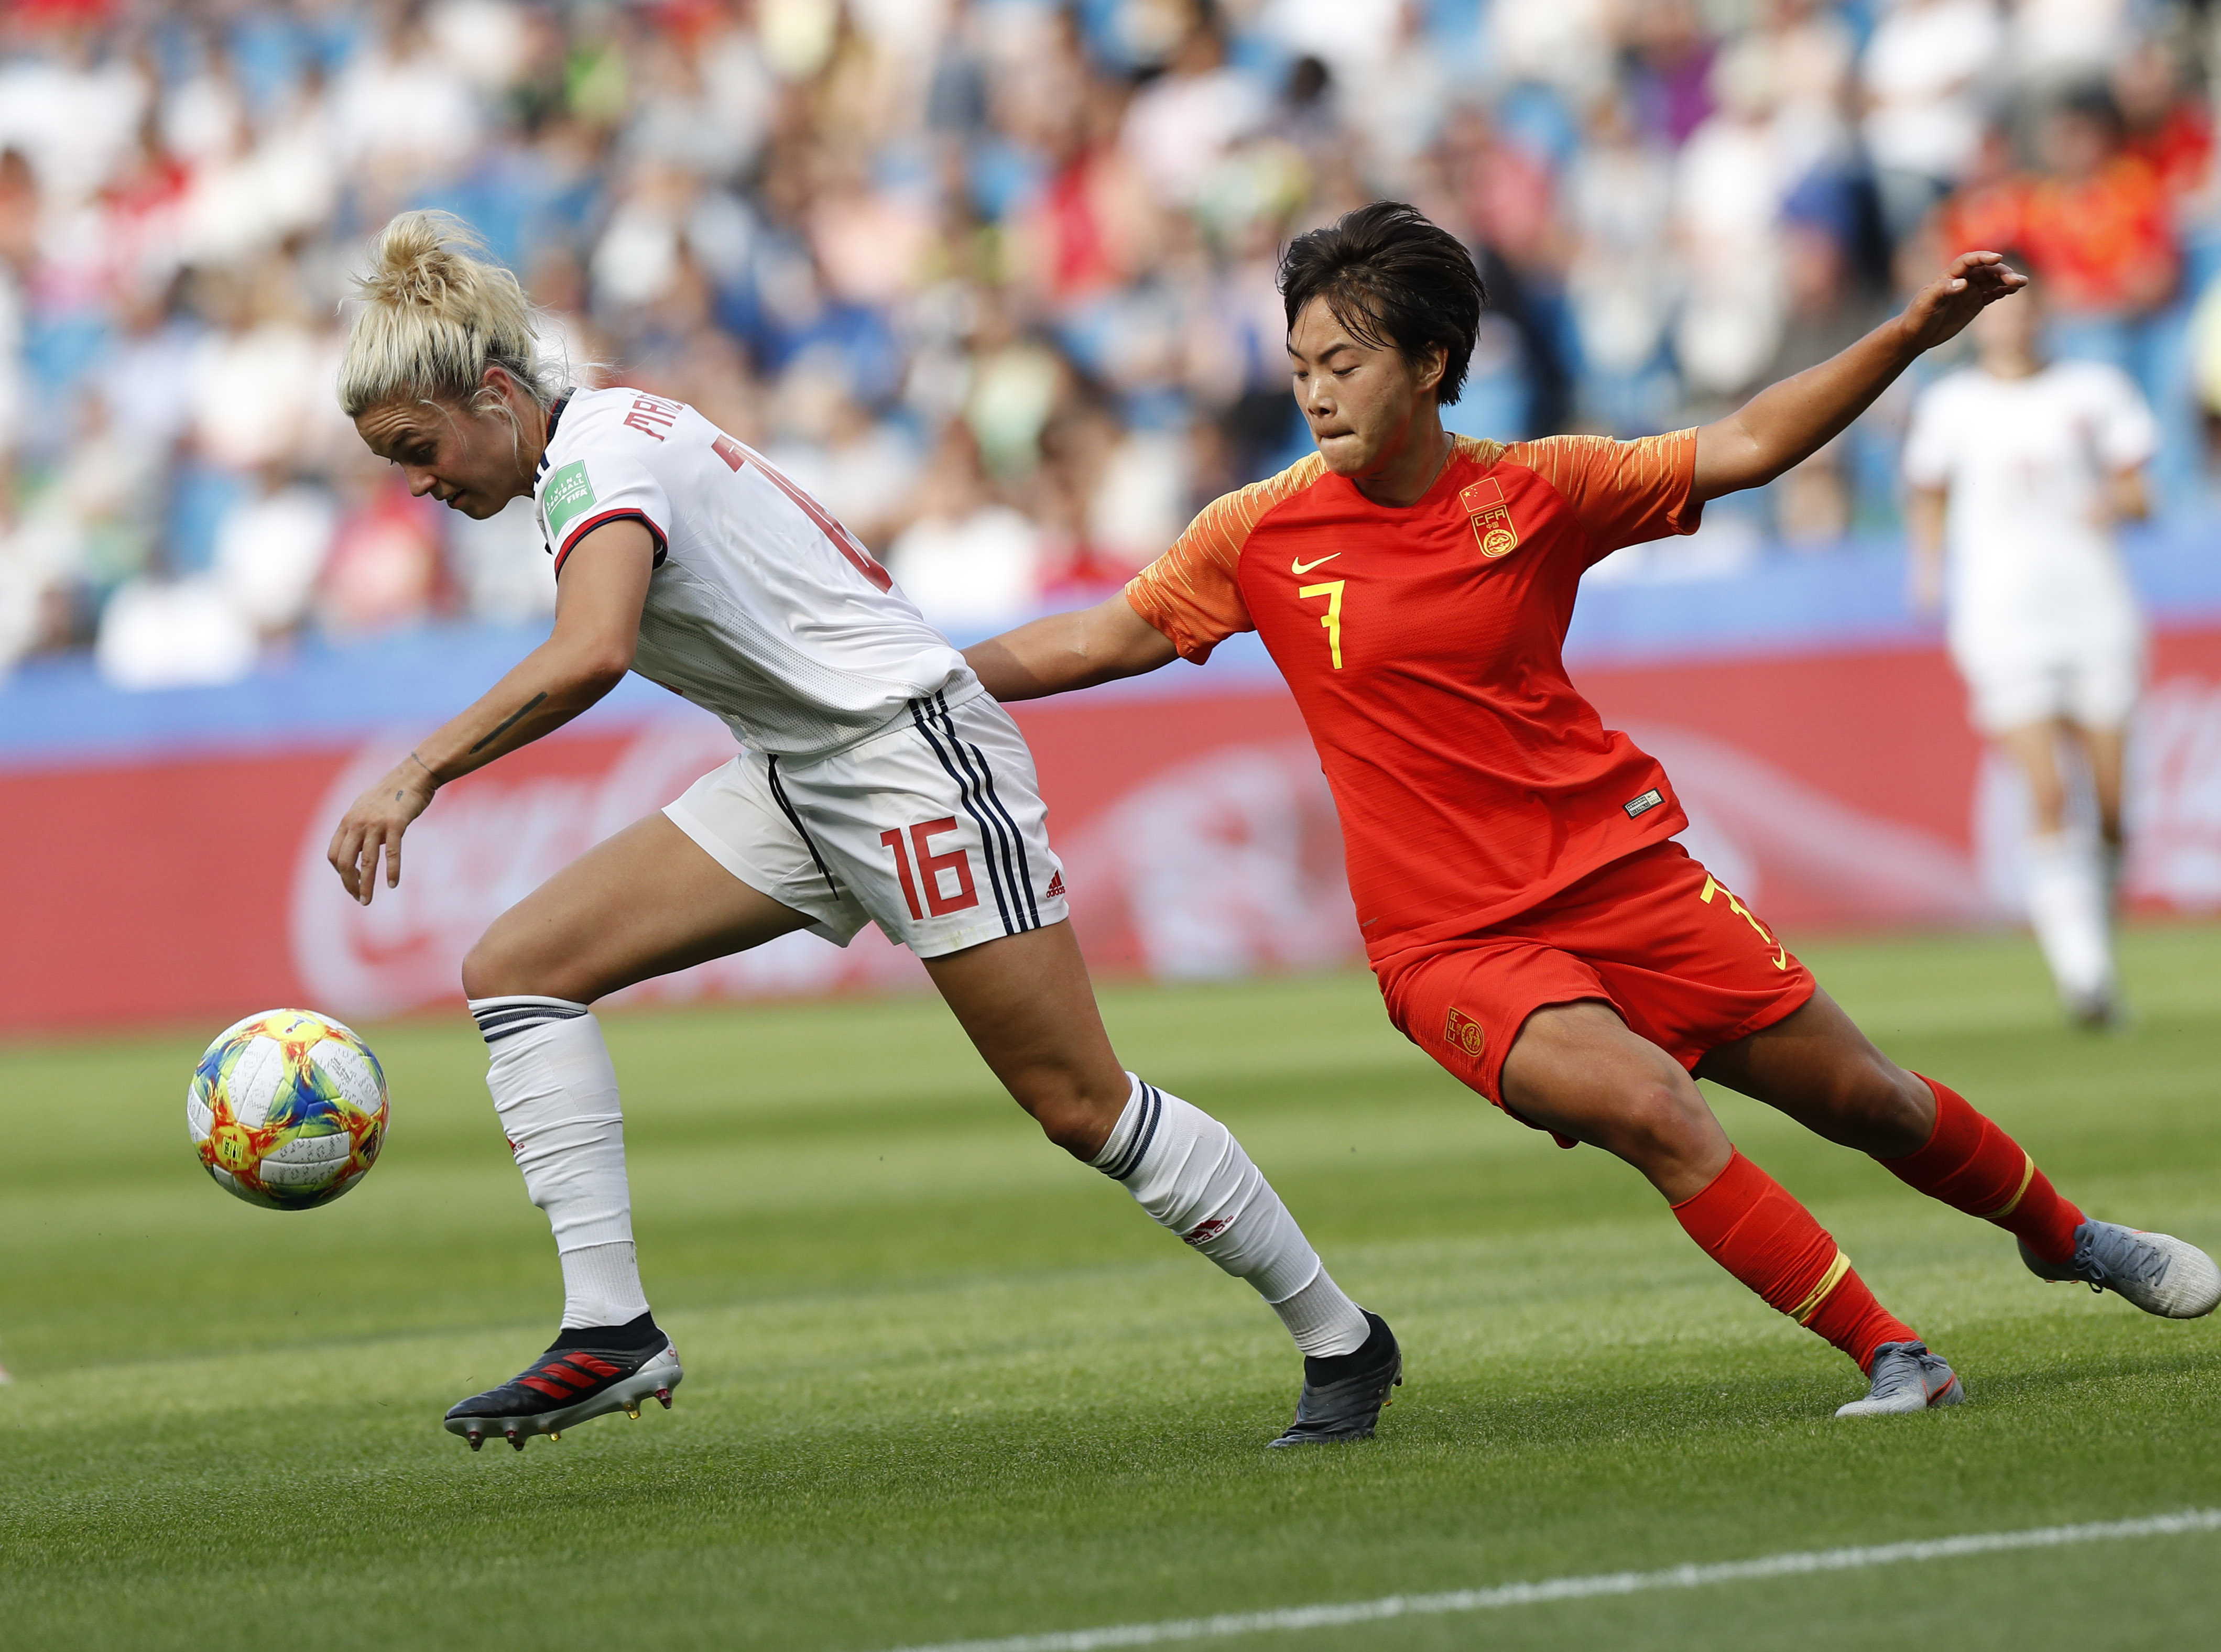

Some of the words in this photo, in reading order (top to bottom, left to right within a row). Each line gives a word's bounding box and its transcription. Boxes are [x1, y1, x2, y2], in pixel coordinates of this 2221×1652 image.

[547, 472, 583, 507] LIVING
[548, 478, 584, 512] FOOTBALL
[567, 488, 588, 504] FIFA
[1475, 509, 1506, 527] CFA
[1299, 579, 1345, 670] 7
[879, 815, 979, 921] 16
[1046, 885, 1066, 899] adidas
[1700, 873, 1771, 945] 7
[1447, 1011, 1459, 1042] CFA
